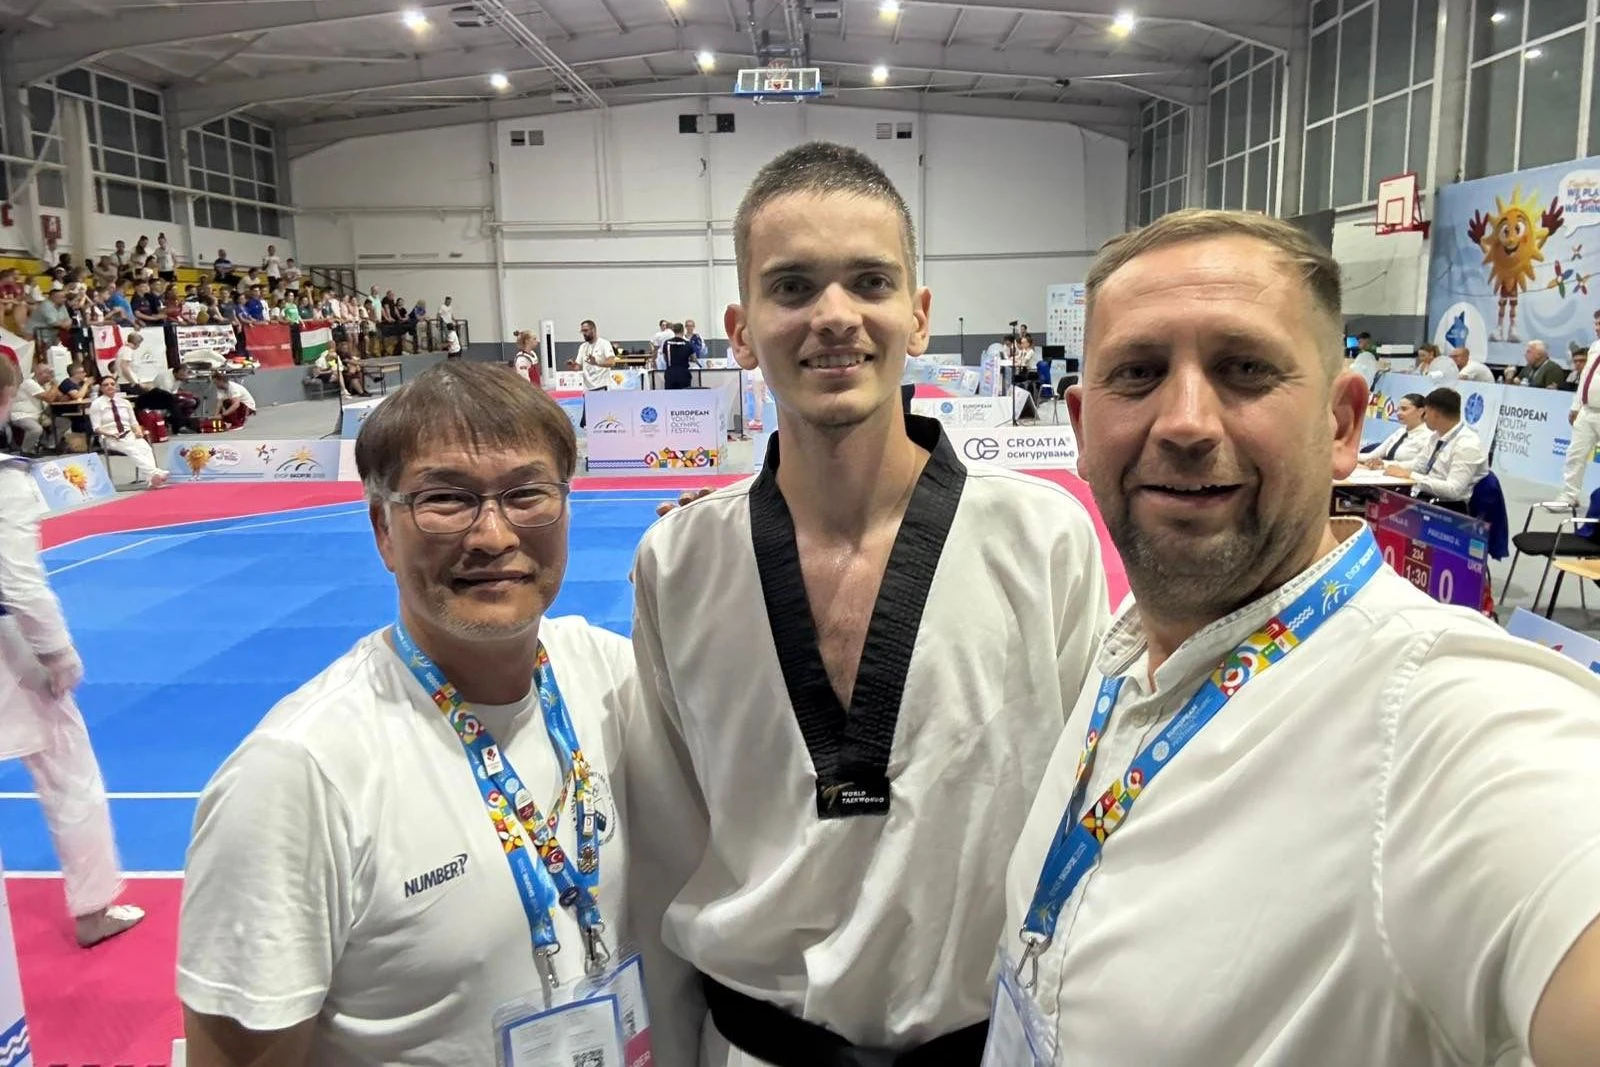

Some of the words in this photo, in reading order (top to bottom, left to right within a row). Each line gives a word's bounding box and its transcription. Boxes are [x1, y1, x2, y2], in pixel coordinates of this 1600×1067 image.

[1499, 404, 1548, 422] EUROPEAN
[1498, 417, 1527, 430] YOUTH
[1006, 437, 1067, 448] CROATIA
[1496, 428, 1532, 446] OLYMPIC
[1495, 441, 1530, 457] FESTIVAL
[1411, 548, 1424, 561] 234
[1405, 564, 1428, 588] 1:30
[1438, 569, 1453, 604] 0
[1166, 703, 1198, 738] EUROPEAN
